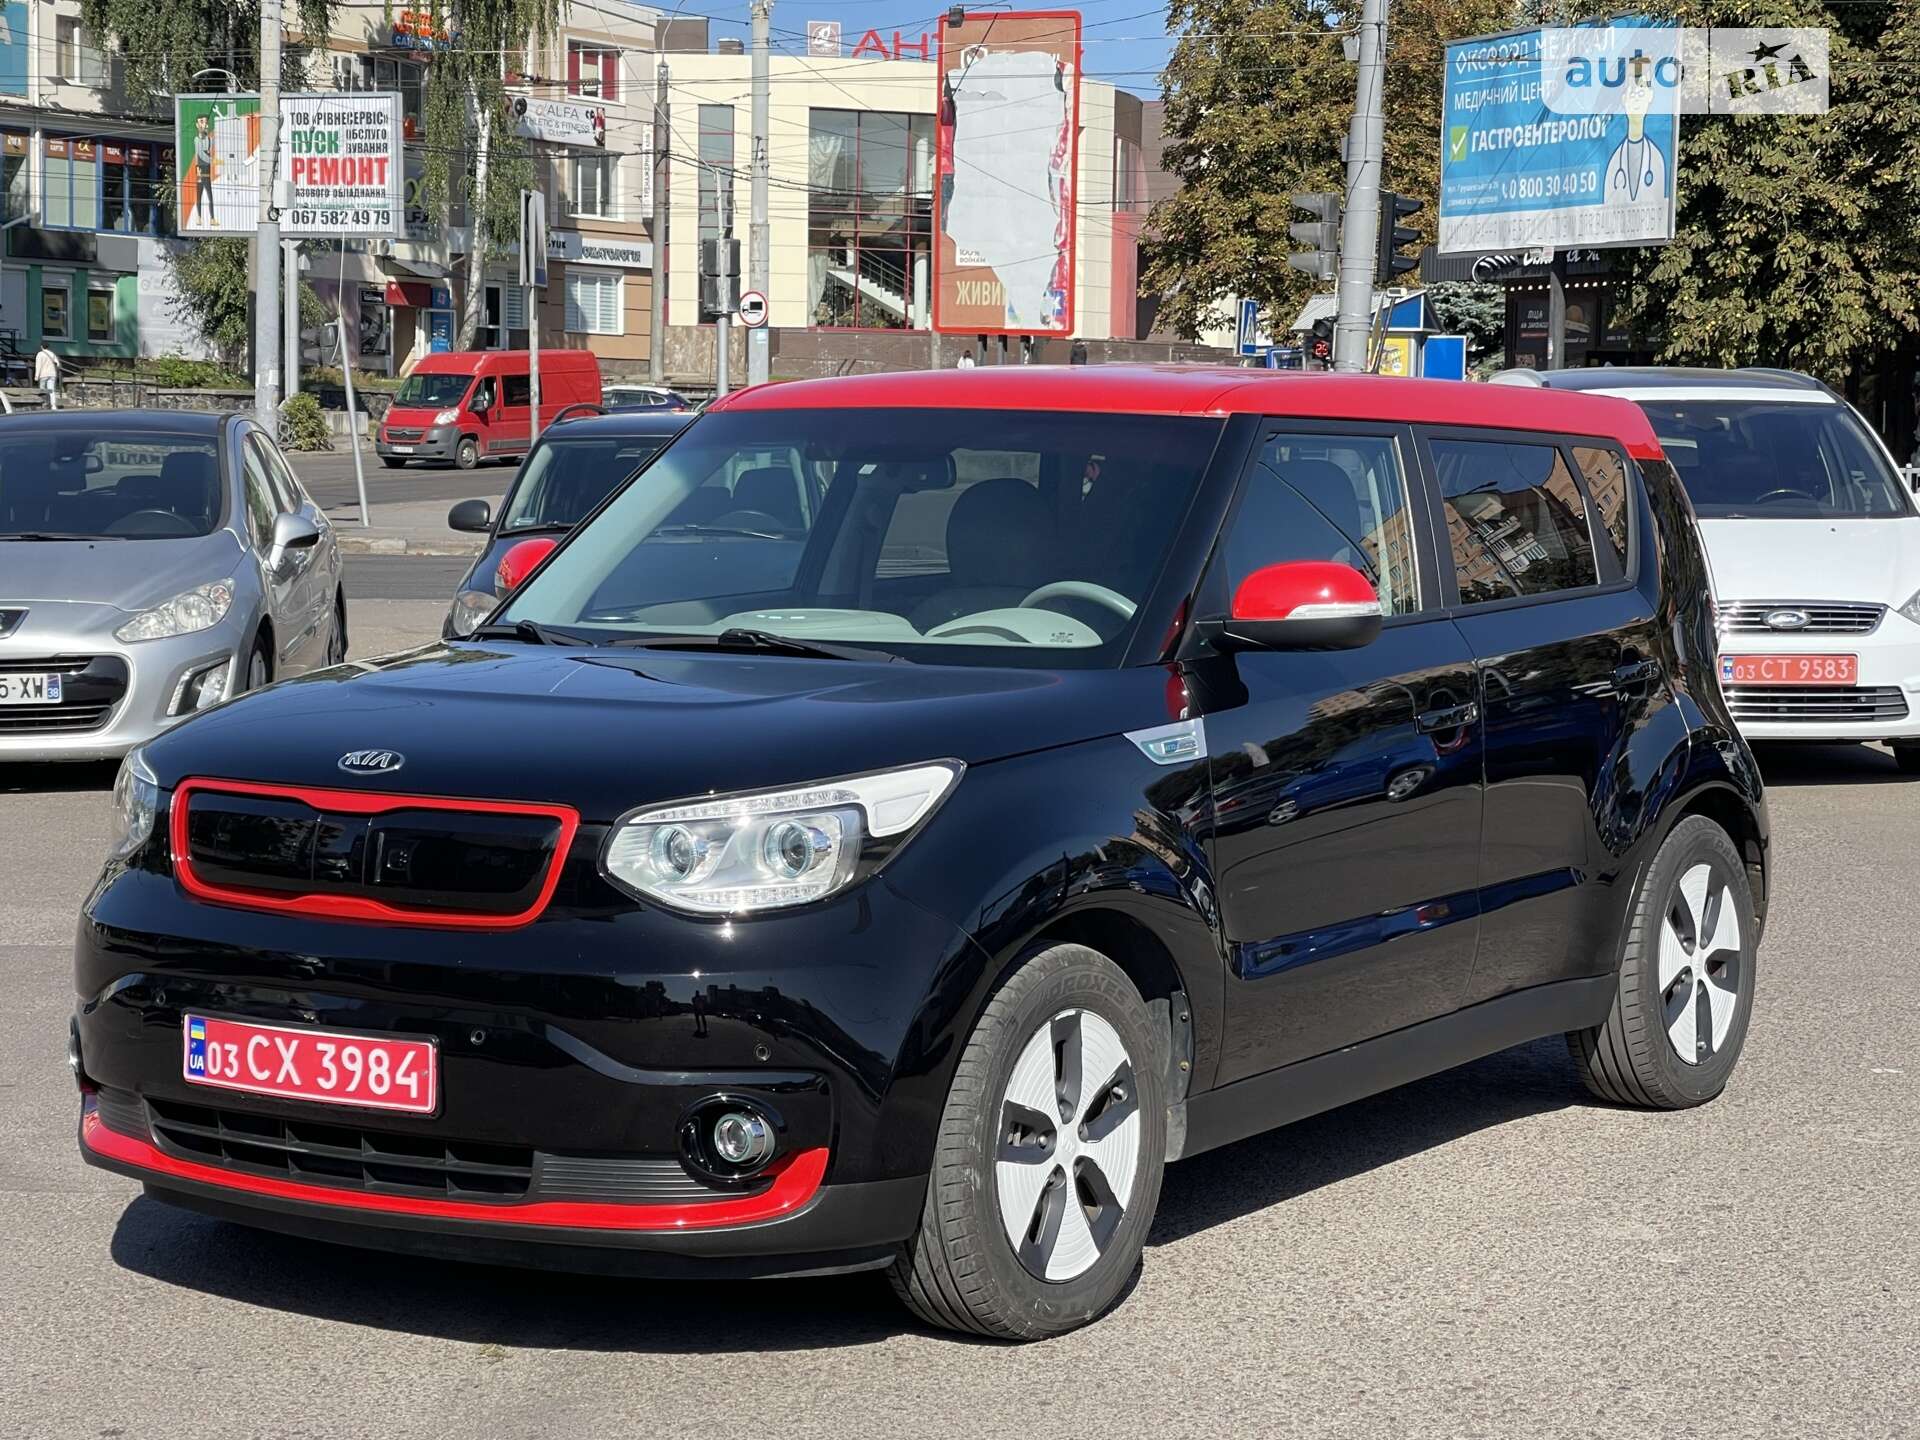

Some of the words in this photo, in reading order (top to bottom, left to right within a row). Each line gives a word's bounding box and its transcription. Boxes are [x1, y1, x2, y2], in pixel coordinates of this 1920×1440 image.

[1455, 39, 1529, 75] ОКСФОРД
[1454, 82, 1519, 113] МЕДИЧНИЙ
[1521, 79, 1559, 103] ЦЕНТР
[290, 112, 309, 126] ТОВ
[547, 104, 579, 119] ALFA
[561, 120, 590, 132] FITNESS
[1471, 114, 1611, 151] ГАСТРОЕНТЕРОЛОГ
[291, 130, 339, 154] ПУСК
[291, 157, 388, 186] РЕМОНТ
[295, 188, 330, 198] АЗОВОГО
[1509, 178, 1517, 200] 0
[1519, 175, 1543, 199] 800
[1545, 173, 1561, 197] 30
[1562, 172, 1577, 195] 40
[1580, 169, 1597, 193] 50
[291, 210, 317, 225] 067
[320, 211, 348, 225] 582
[352, 211, 370, 225] 49
[373, 210, 390, 225] 79
[1735, 665, 1756, 680] 03
[1761, 659, 1792, 679] CT
[1799, 659, 1849, 680] 9583
[47, 687, 59, 698] 38
[344, 751, 393, 769] KIA
[189, 1054, 205, 1071] UA
[207, 1041, 240, 1078] 03
[246, 1034, 302, 1086] CX
[315, 1042, 419, 1099] 3984
